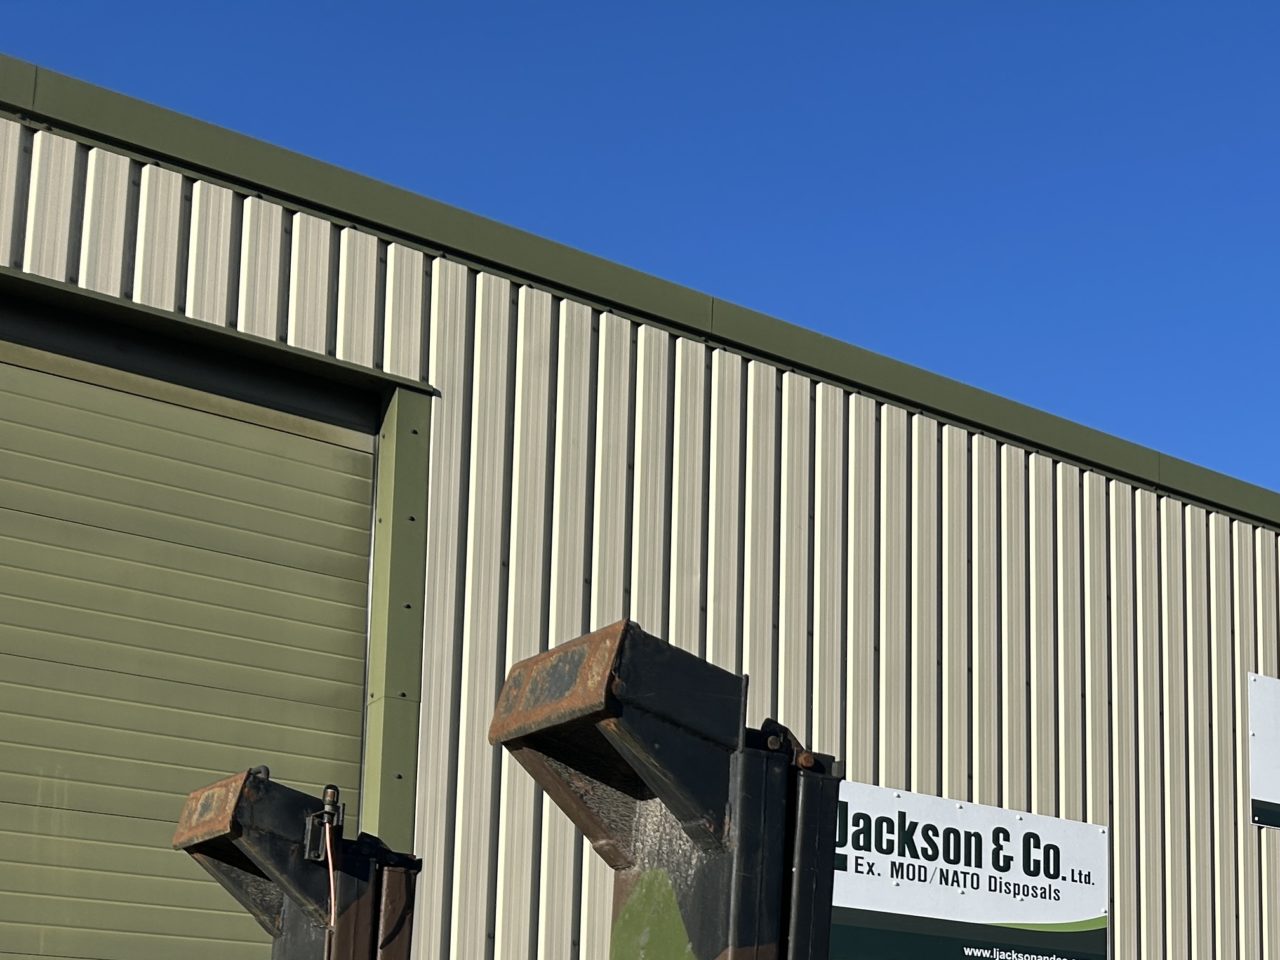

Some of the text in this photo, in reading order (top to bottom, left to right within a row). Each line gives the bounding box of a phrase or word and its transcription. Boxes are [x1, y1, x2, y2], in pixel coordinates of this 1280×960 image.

[833, 800, 1095, 886] Jackson & Co. Ltd.
[854, 856, 1061, 902] Ex. MOD/NATO Disposals
